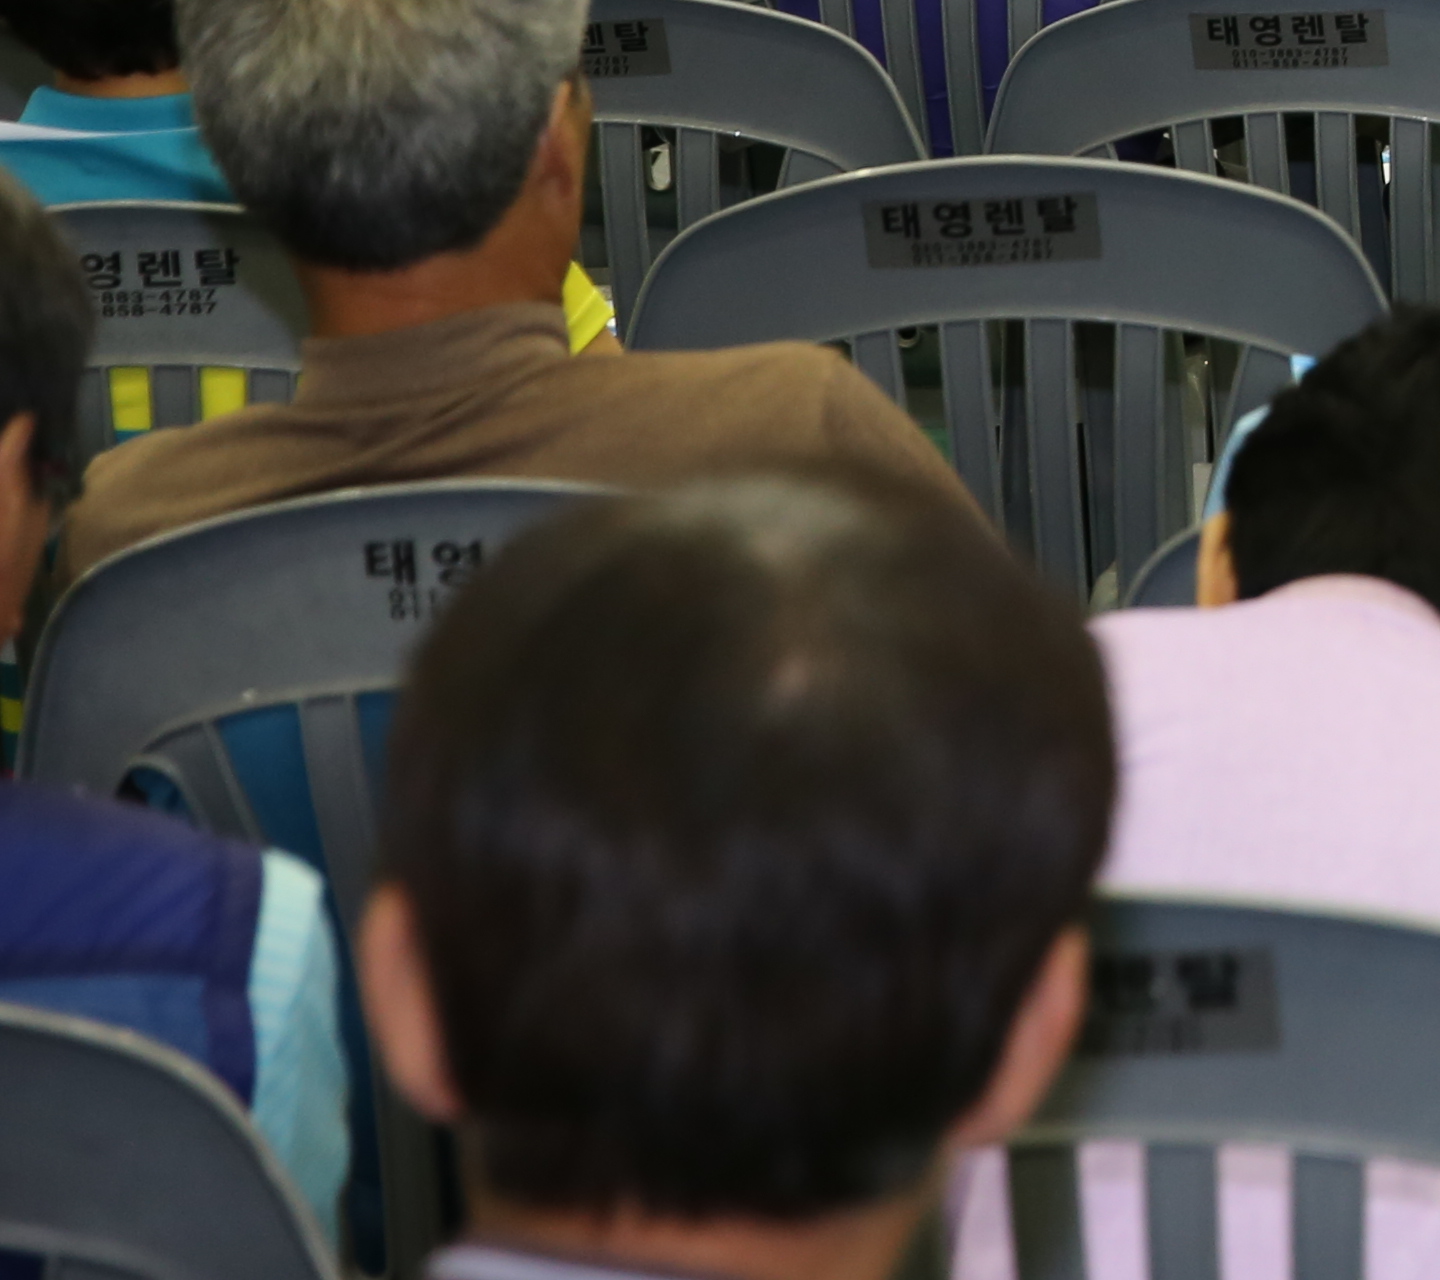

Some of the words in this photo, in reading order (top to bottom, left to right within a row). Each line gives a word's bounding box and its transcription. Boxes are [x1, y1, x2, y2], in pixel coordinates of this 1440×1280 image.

[1207, 11, 1370, 47] 태영렌탈
[882, 192, 1080, 241] 태영렌탈
[82, 246, 241, 292] 영렌탈
